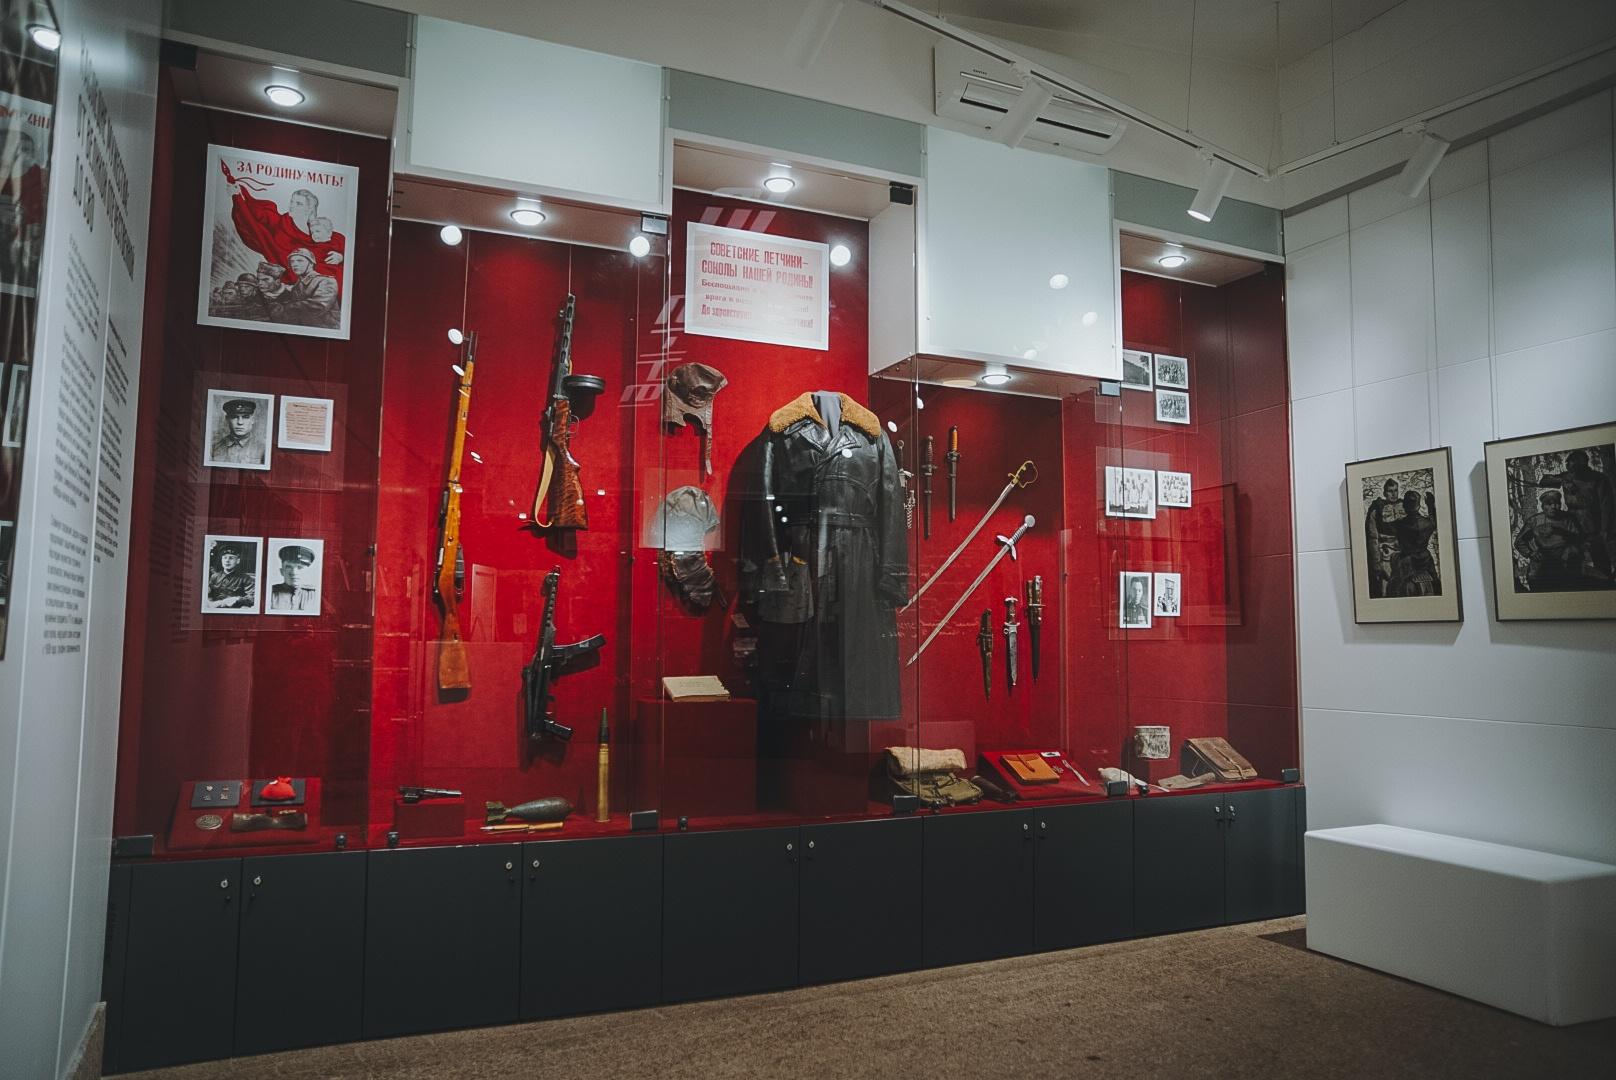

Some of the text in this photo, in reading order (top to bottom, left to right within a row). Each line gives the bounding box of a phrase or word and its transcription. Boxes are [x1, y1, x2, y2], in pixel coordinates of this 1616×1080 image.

[236, 161, 344, 187] ЗА РОДИНУ МАТЬ!
[710, 242, 760, 262] СОВЕТСКИЕ
[701, 259, 738, 278] СОКОЛЫ
[742, 266, 773, 283] НАШЕЙ
